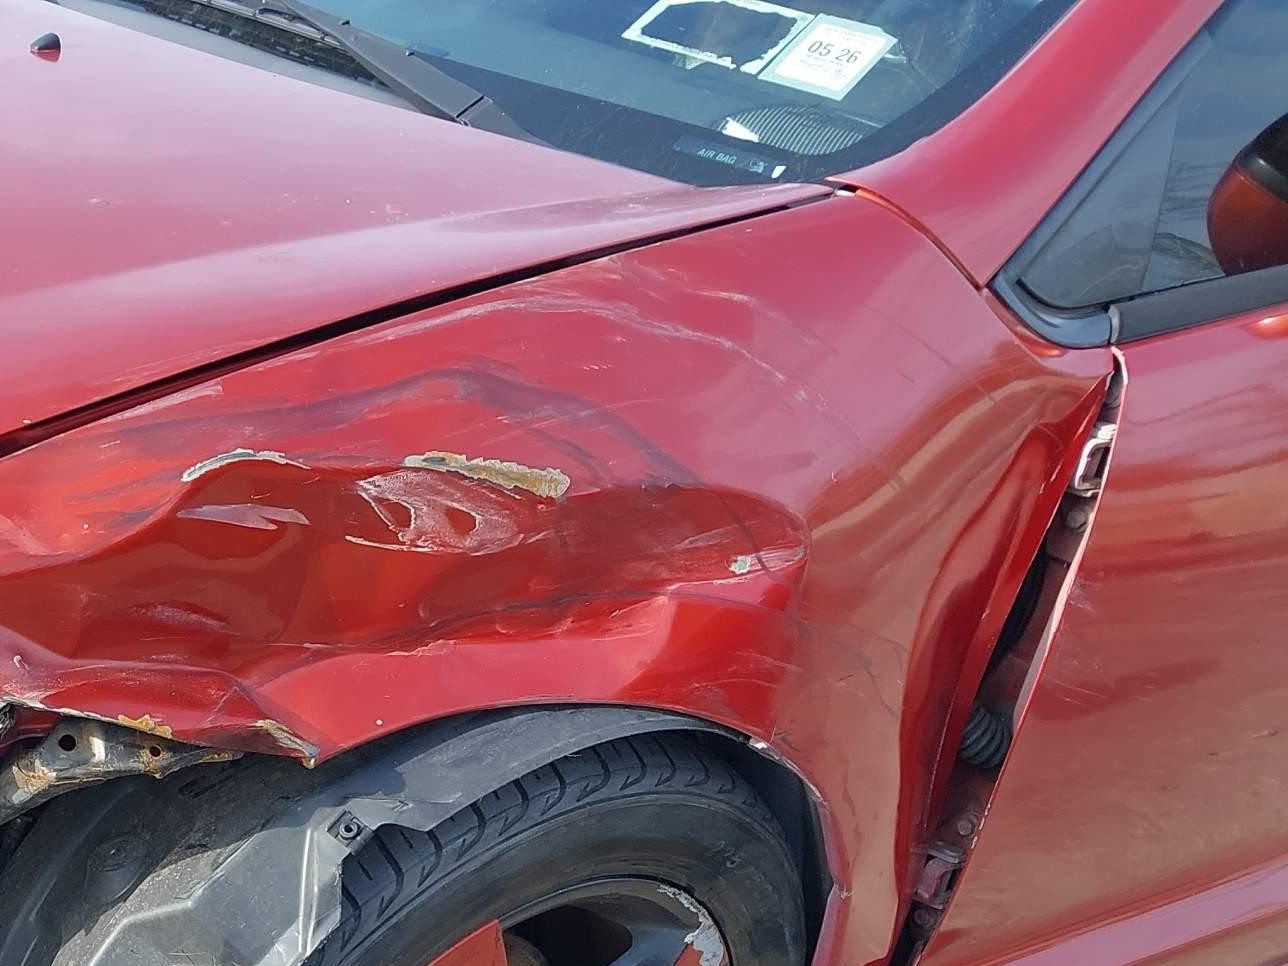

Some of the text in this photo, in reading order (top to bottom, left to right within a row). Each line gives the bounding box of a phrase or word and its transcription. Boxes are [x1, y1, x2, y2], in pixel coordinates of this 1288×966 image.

[807, 41, 835, 56] 05
[835, 48, 862, 64] 26
[696, 148, 737, 164] AIR BAG
